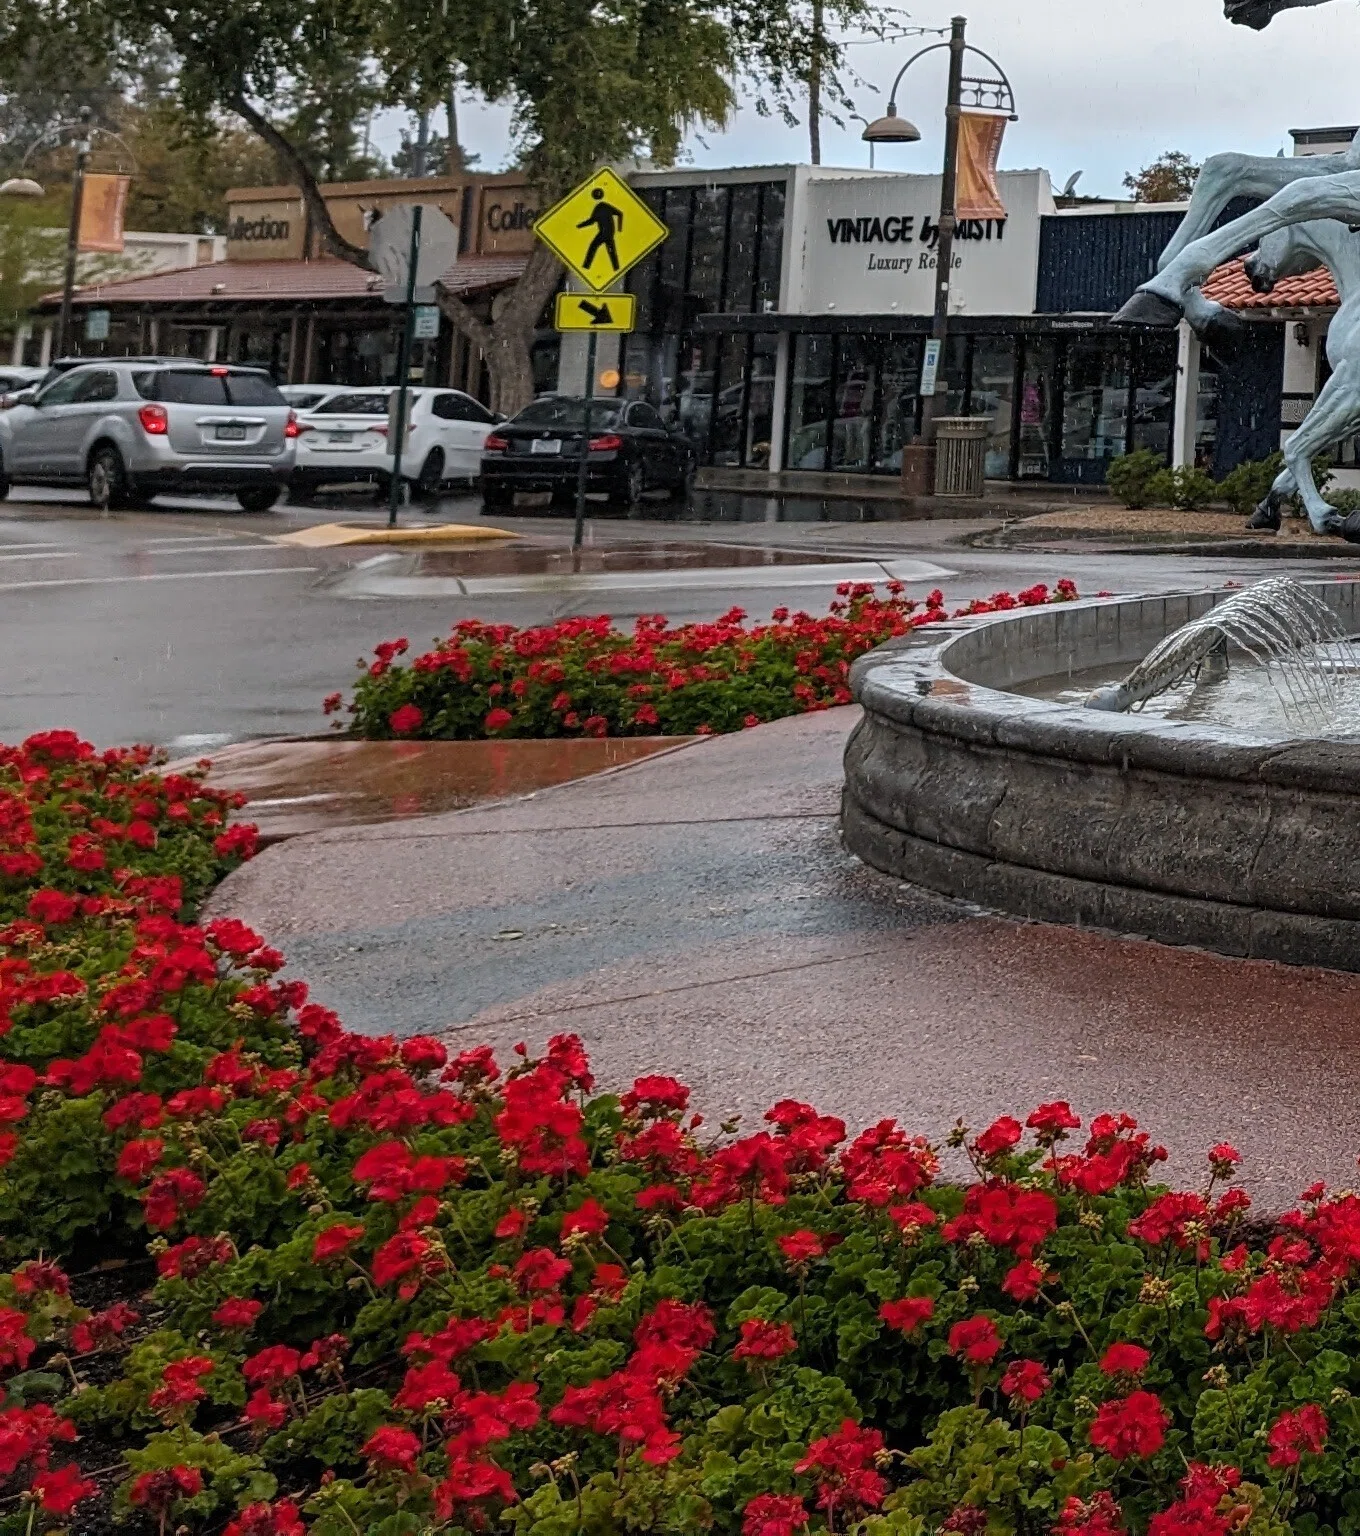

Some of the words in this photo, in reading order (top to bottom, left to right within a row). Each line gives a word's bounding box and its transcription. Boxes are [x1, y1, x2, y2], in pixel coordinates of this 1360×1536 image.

[227, 215, 290, 241] ollection
[827, 216, 914, 243] VINTAGE
[868, 253, 913, 274] Luxury
[918, 252, 962, 270] Rele
